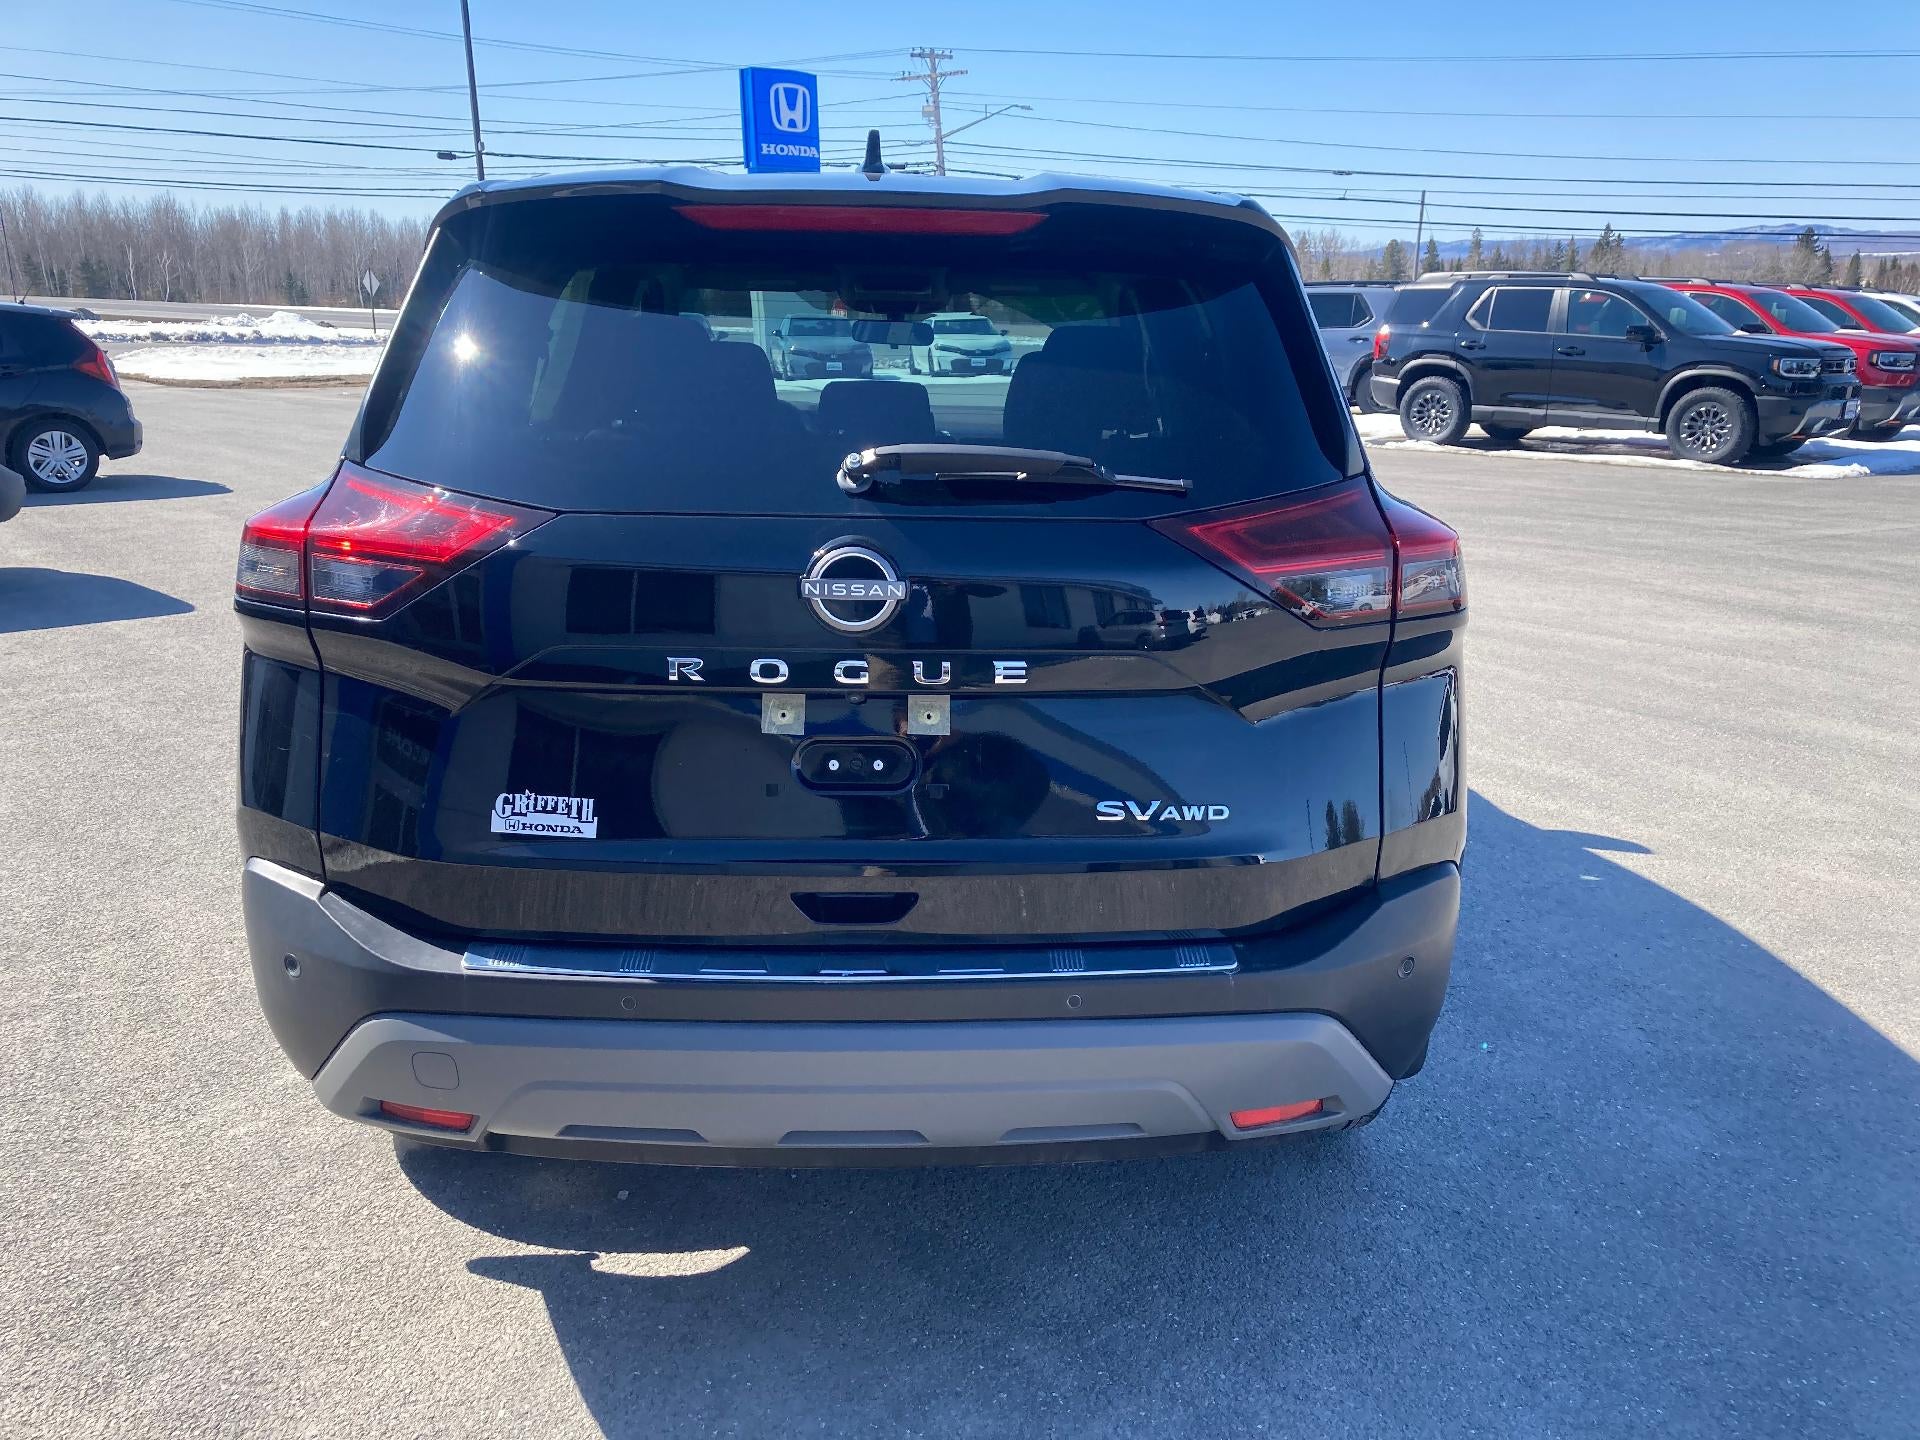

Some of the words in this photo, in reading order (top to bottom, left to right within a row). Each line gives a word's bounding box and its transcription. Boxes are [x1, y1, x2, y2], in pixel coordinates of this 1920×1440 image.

[761, 143, 820, 158] HONDA
[804, 582, 902, 597] NISSAN
[666, 656, 1029, 684] ROGUE
[495, 791, 595, 822] GRIFFETH
[521, 822, 584, 834] HONDA
